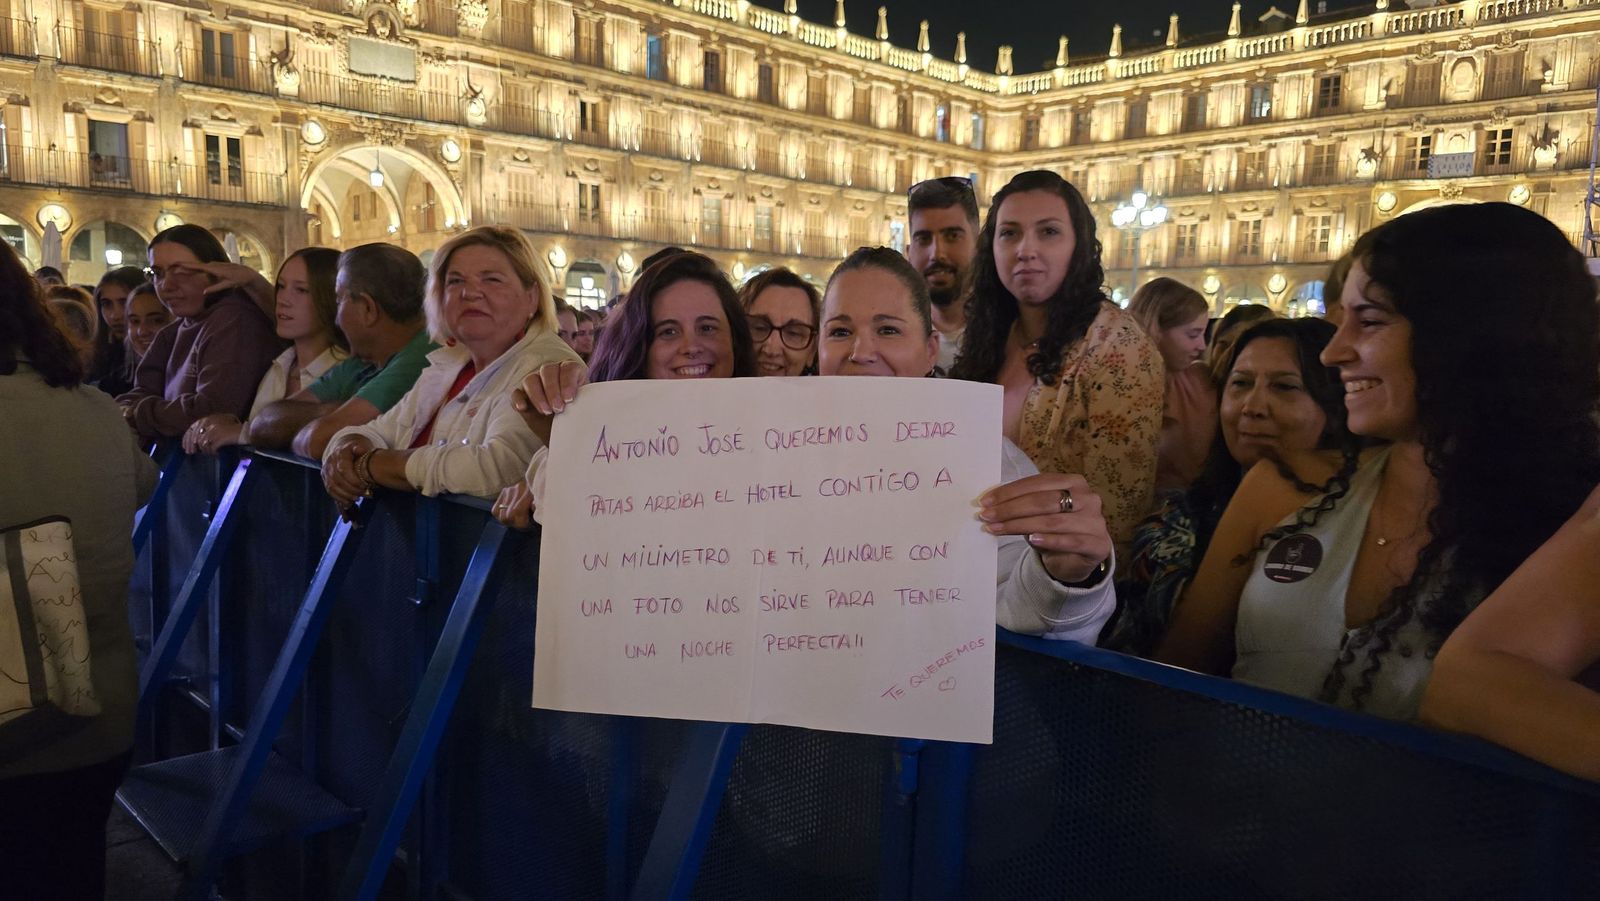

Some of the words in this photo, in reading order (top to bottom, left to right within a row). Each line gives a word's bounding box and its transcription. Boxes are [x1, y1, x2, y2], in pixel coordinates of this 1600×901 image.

[592, 424, 680, 464] ANTONIO
[764, 423, 869, 453] QUEREMOS
[896, 421, 957, 443] DEJAR
[589, 494, 634, 517] PATAS
[643, 490, 705, 514] ARRIBA
[714, 489, 735, 503] EL
[747, 479, 802, 505] HOTEL
[818, 468, 920, 497] CONTIGO
[932, 467, 953, 489] A
[583, 551, 609, 571] UN
[621, 544, 731, 569] MILIMETRO
[752, 548, 779, 566] DE
[821, 543, 895, 568] AUNQUE
[908, 541, 949, 562] CON
[580, 598, 613, 618] UNA
[632, 597, 684, 616] FOTO
[705, 593, 741, 616] NOS
[759, 588, 810, 612] SIRVE
[825, 588, 875, 609] PARA
[893, 586, 962, 606] TENER
[624, 643, 657, 660] UNA
[680, 640, 735, 664] NOCHE
[880, 684, 906, 701] TE
[908, 637, 986, 689] QUEREMOS
